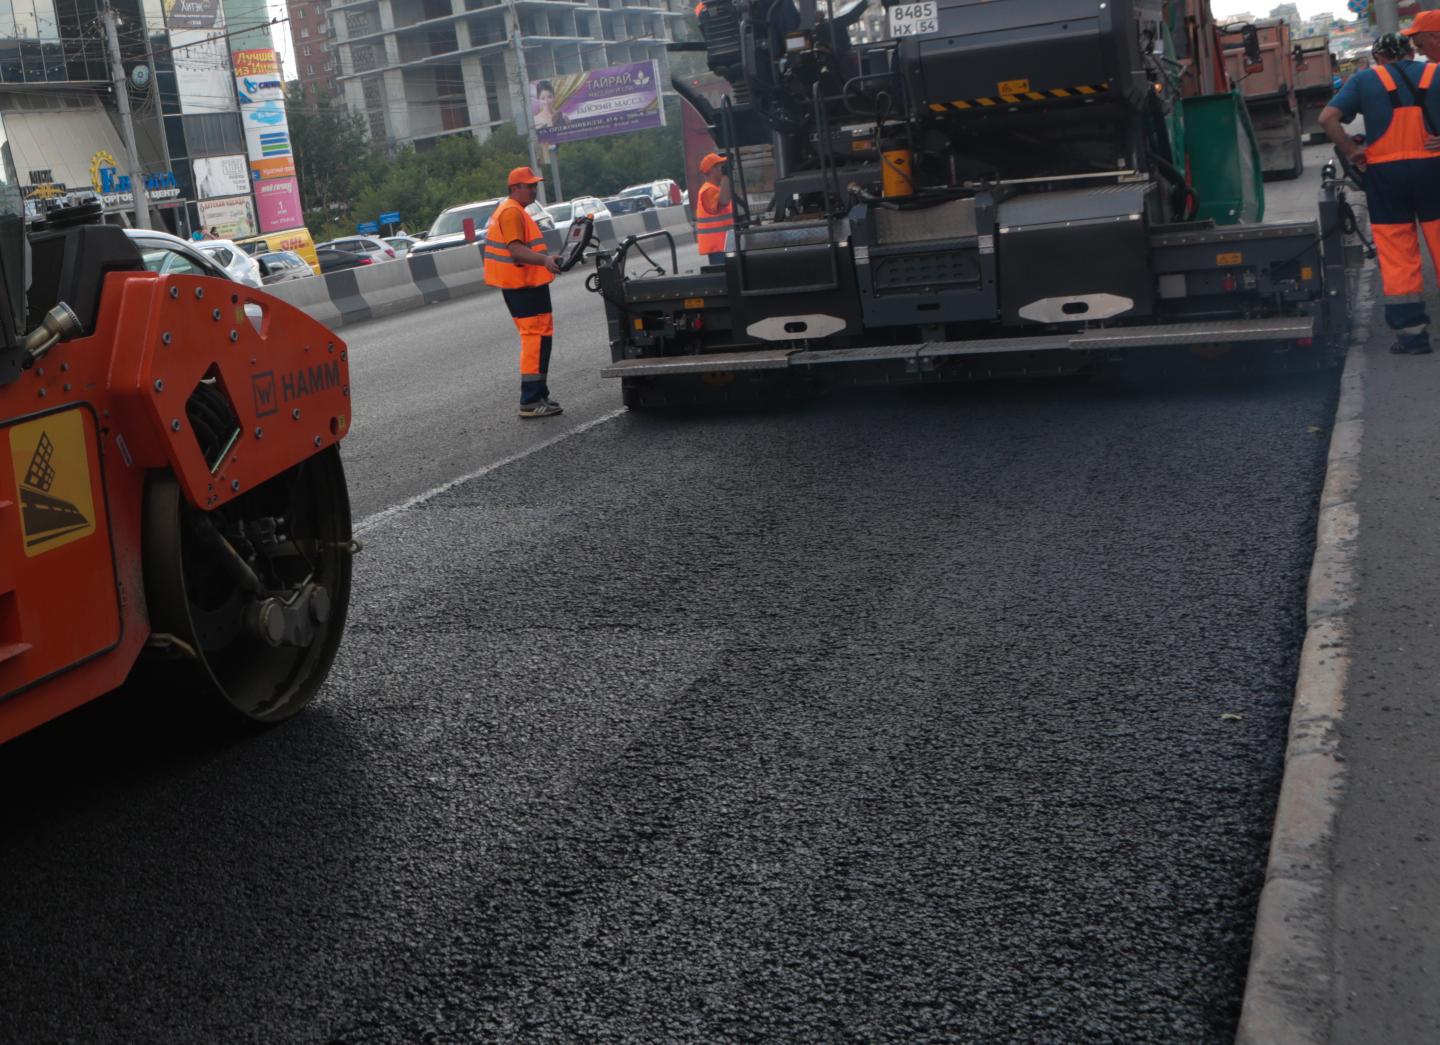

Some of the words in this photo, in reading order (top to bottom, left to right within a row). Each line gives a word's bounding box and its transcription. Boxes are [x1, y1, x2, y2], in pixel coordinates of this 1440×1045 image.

[895, 4, 932, 20] 8485
[920, 21, 935, 32] 54
[587, 72, 631, 91] ТАЙРАЙ
[100, 191, 150, 204] ТОРГОВЙ
[151, 189, 180, 201] ЦЕНТР
[281, 238, 306, 251] DHL
[281, 359, 340, 402] HAMM
